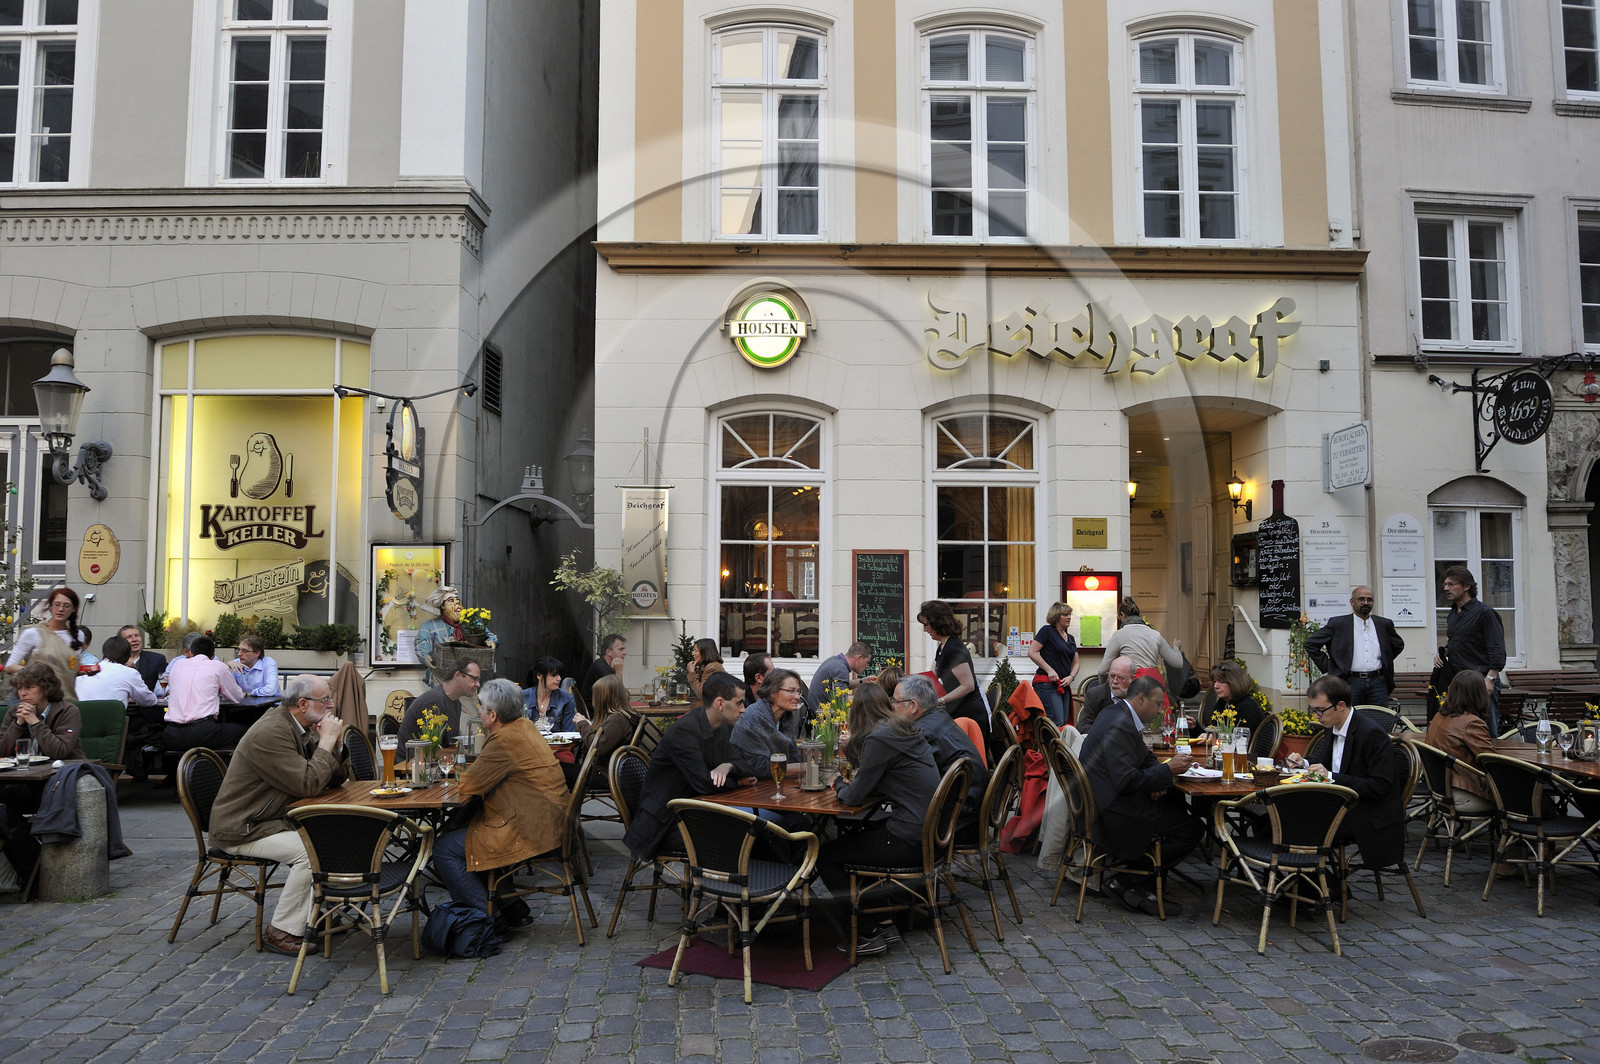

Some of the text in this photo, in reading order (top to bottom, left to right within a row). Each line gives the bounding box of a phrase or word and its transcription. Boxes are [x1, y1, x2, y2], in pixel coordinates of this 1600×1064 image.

[737, 322, 798, 334] HOLSTEN
[924, 287, 1302, 378] Deichgraf
[1511, 380, 1536, 394] Zum
[1509, 395, 1540, 422] 1659
[626, 501, 665, 511] Deichgraf
[199, 504, 325, 538] KARTOFFEL
[227, 525, 297, 546] KELLER
[1075, 528, 1104, 537] Deichgraf
[213, 564, 300, 603] Duckstein
[1268, 582, 1284, 590] oder
[1267, 596, 1284, 604] oder
